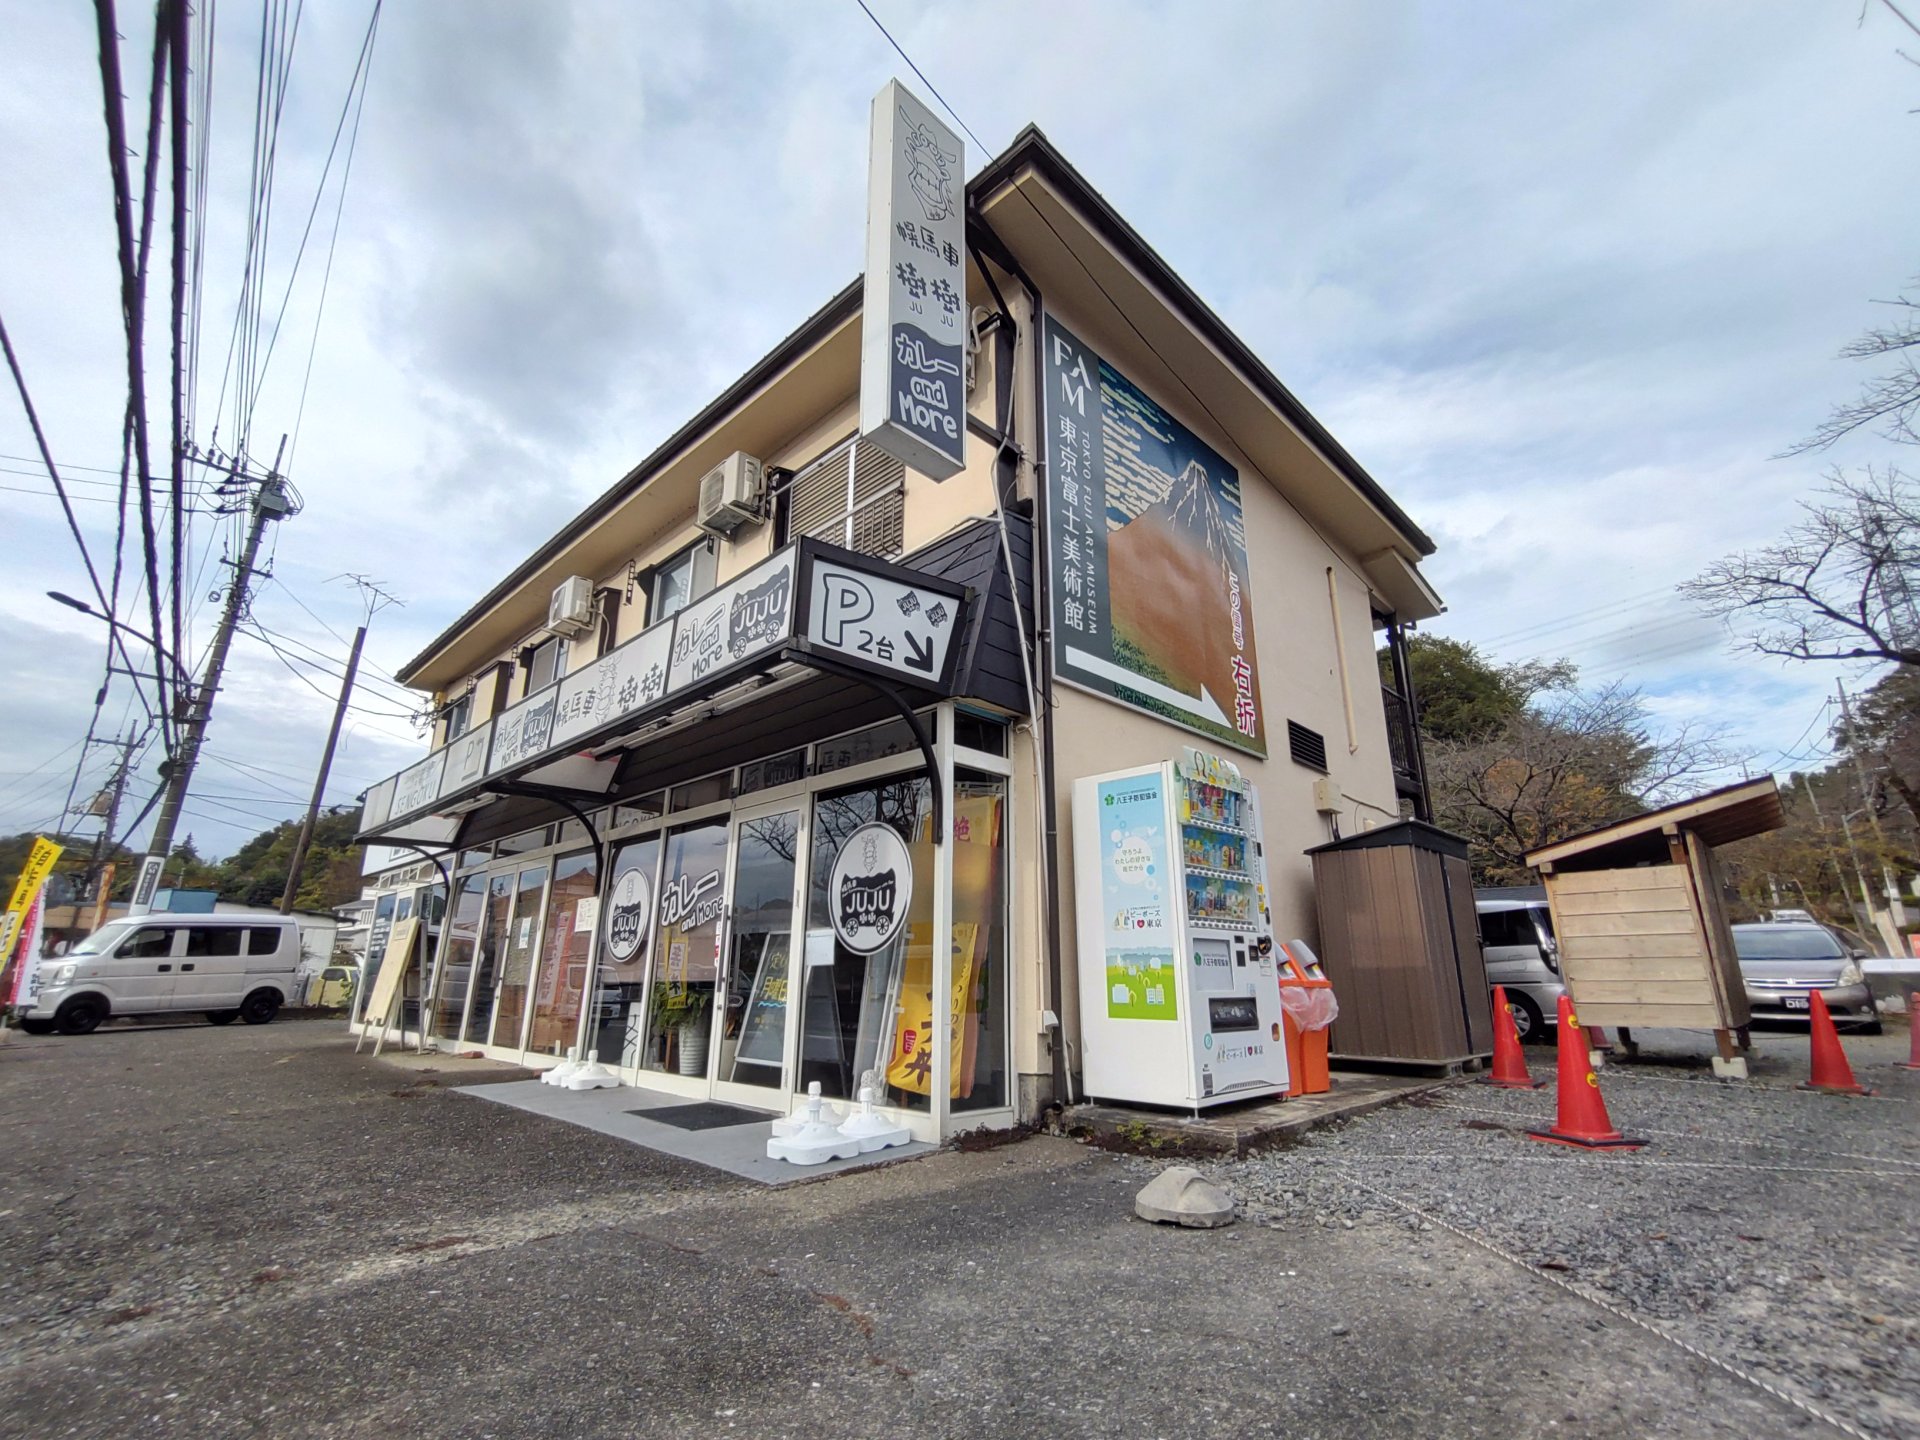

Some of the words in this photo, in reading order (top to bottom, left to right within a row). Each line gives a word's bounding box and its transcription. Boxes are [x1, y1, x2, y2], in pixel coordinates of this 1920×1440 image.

[895, 220, 959, 268] 幌馬車
[895, 261, 961, 315] 樹樹
[909, 301, 923, 315] JU
[940, 315, 954, 328] JU
[895, 332, 960, 377] カレー
[912, 378, 947, 408] and
[898, 390, 959, 439] More
[1081, 429, 1091, 480] TOKYO
[1058, 413, 1084, 631] 東京富士美術館
[1083, 484, 1093, 520] FUJI
[1085, 523, 1094, 558] ART
[734, 588, 783, 634] JUJU
[821, 572, 875, 648] P
[1086, 561, 1097, 634] MUSEUM
[673, 602, 726, 668] カレー
[699, 623, 720, 656] and
[857, 629, 895, 662] 2台
[691, 644, 723, 681] More
[1230, 654, 1256, 739] 右折
[524, 713, 551, 740] JUJU
[394, 780, 437, 816] SENGOKU
[661, 868, 720, 926] カレー
[696, 894, 725, 927] More
[845, 888, 891, 914] JUJU
[613, 914, 639, 932] JUJU
